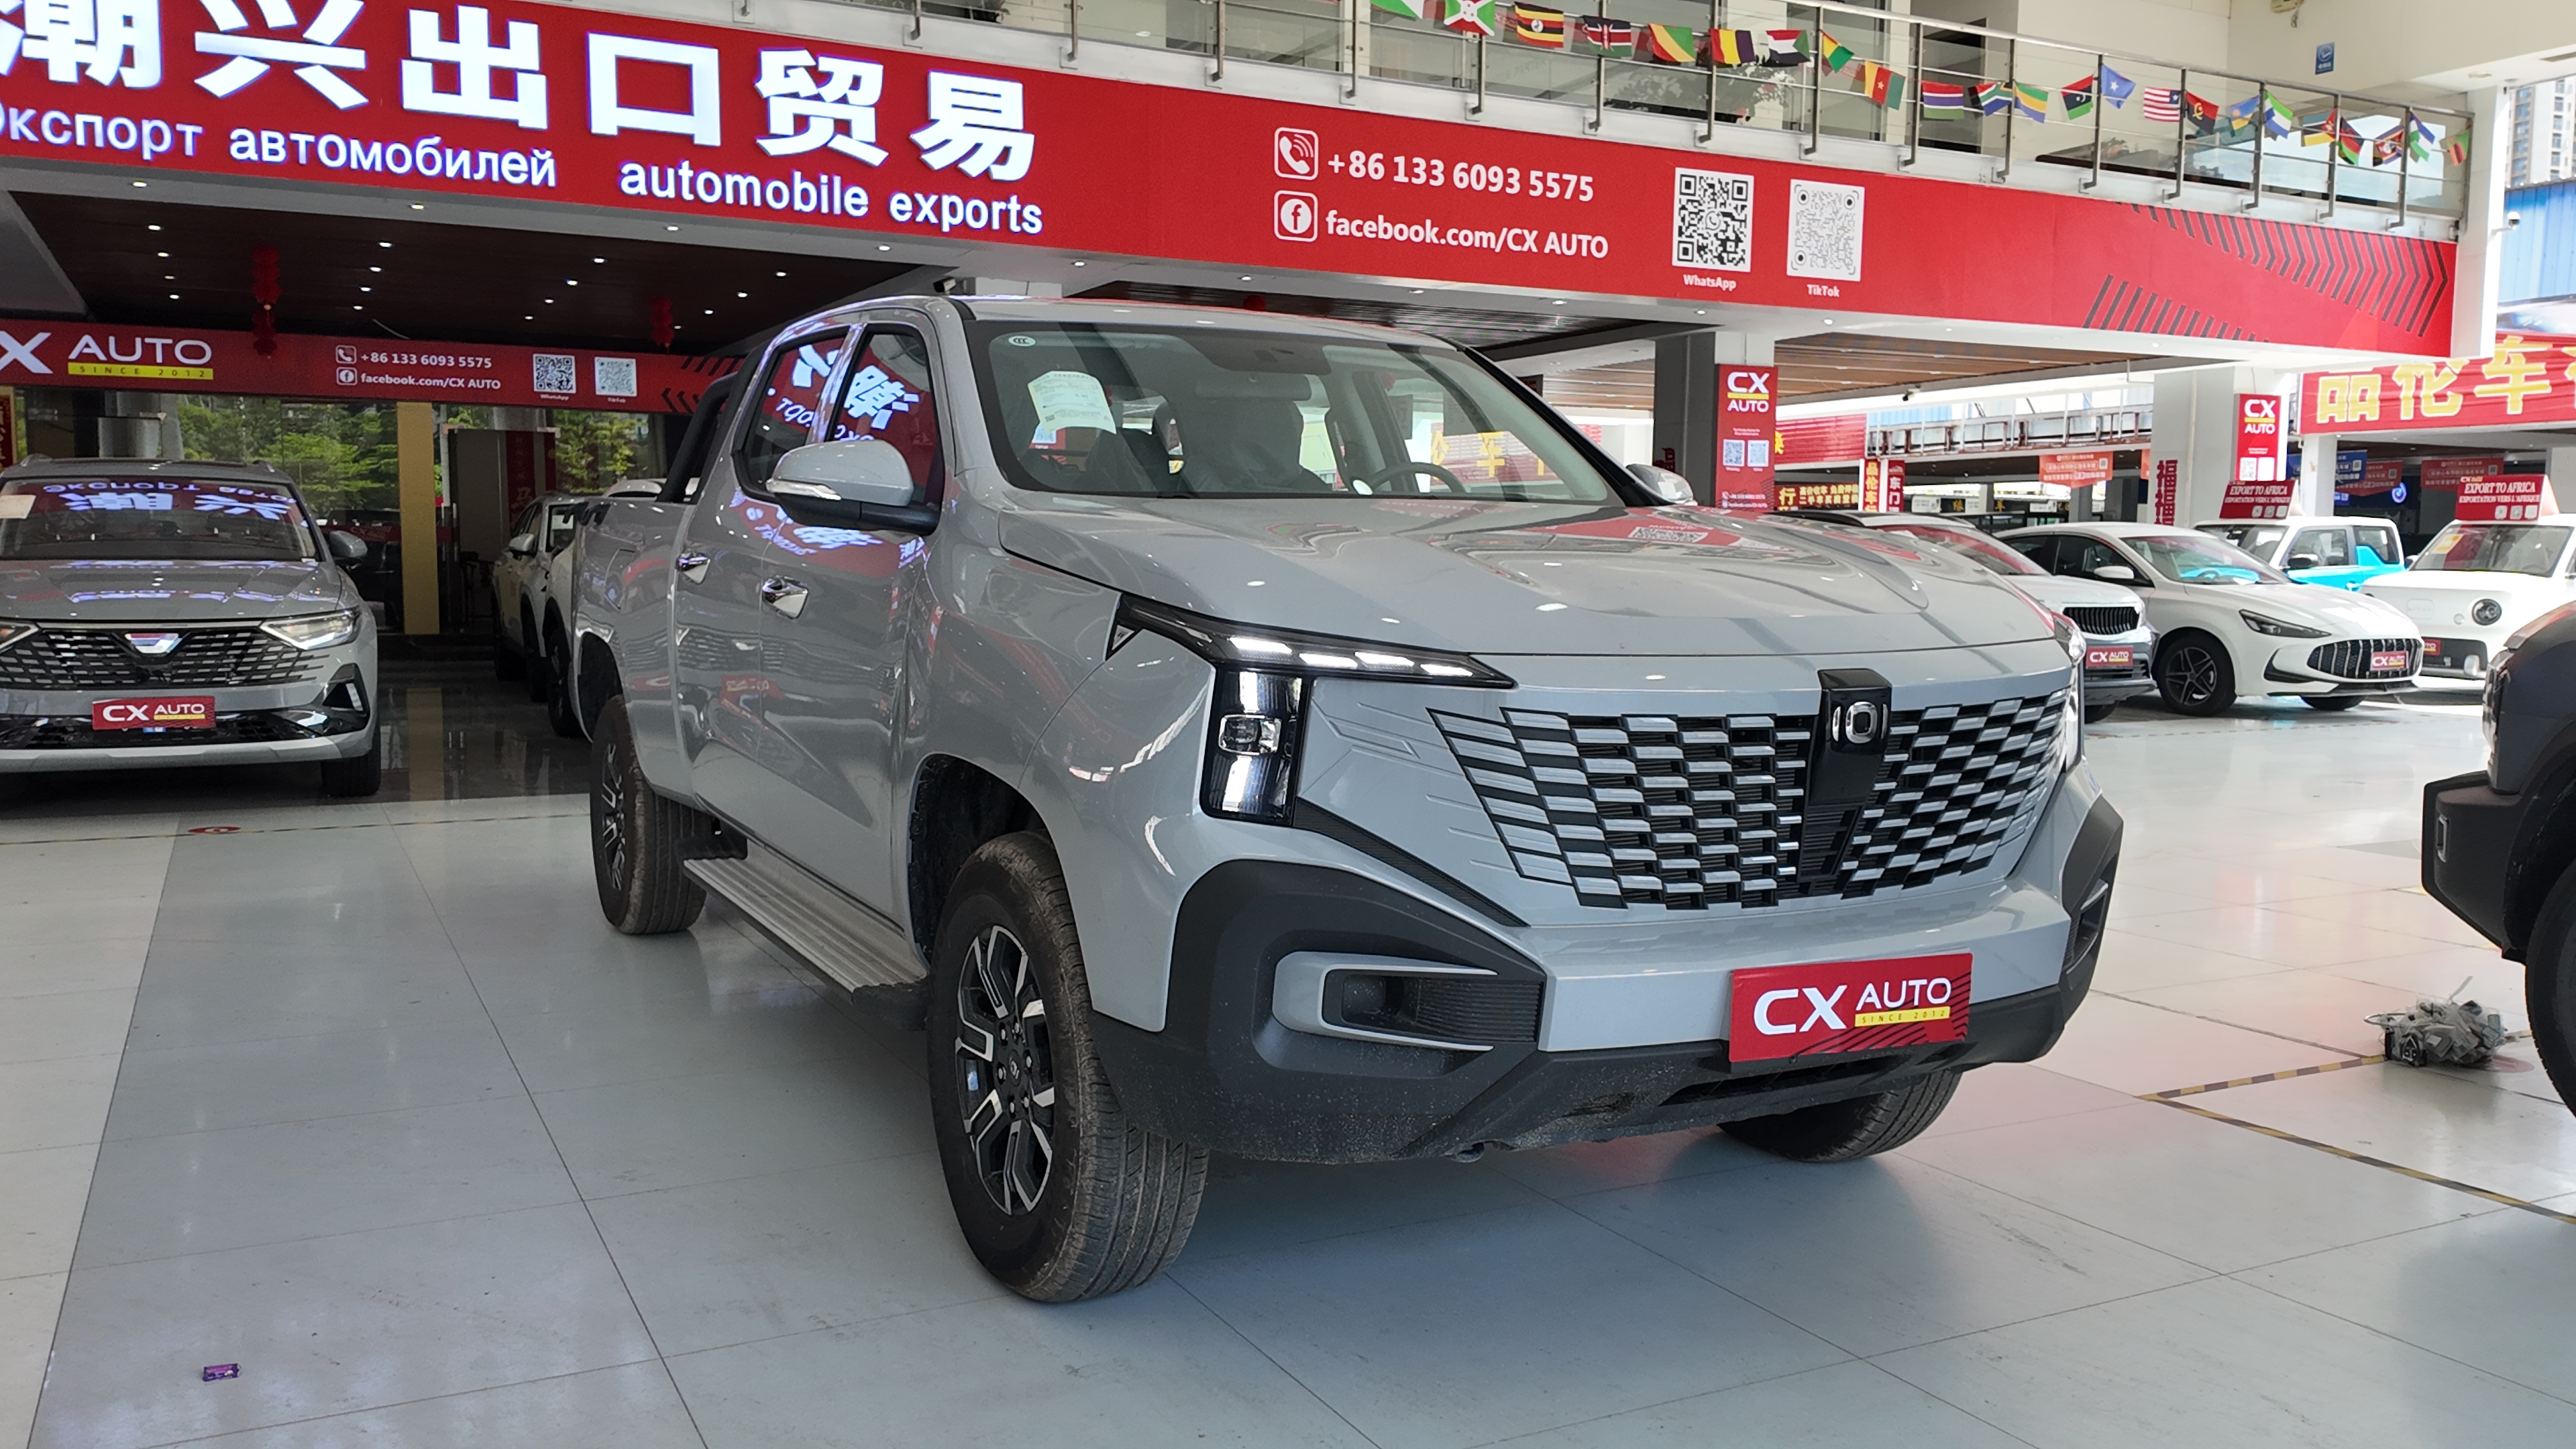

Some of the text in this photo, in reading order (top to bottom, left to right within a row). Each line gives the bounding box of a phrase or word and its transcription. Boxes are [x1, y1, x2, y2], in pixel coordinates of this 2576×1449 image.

[0, 0, 1035, 181] 潮兴出口贸易
[0, 102, 557, 187] кспорт автомобилей
[1328, 151, 1593, 201] +86 133 6093 5575
[620, 160, 1043, 234] automobile exports
[1326, 210, 1609, 258] facebook.com/CX AUTO
[1682, 274, 1737, 291] WhatsApp
[1807, 284, 1840, 297] TikTok
[0, 331, 213, 374] X AUTO
[361, 352, 492, 368] +86 133 6093 5575
[80, 366, 205, 378] SINCE 2012
[360, 373, 501, 389] facebook.com/CX AUTO
[1727, 372, 1770, 393] CX
[1727, 400, 1770, 413] AUTO
[2245, 399, 2276, 418] CX
[2245, 423, 2275, 434] AUTO
[2230, 485, 2288, 496] EXPORT TO AFRICA
[2464, 482, 2494, 494] EXPORT
[2496, 482, 2507, 493] TO
[2507, 481, 2536, 493] AFRICA
[2090, 651, 2108, 663] CX
[2372, 656, 2388, 666] CX
[103, 704, 150, 722] CX
[154, 704, 205, 714] AUTO
[1754, 977, 1952, 1035] CX AUTO
[1862, 1010, 1945, 1024] SINCE 2012
